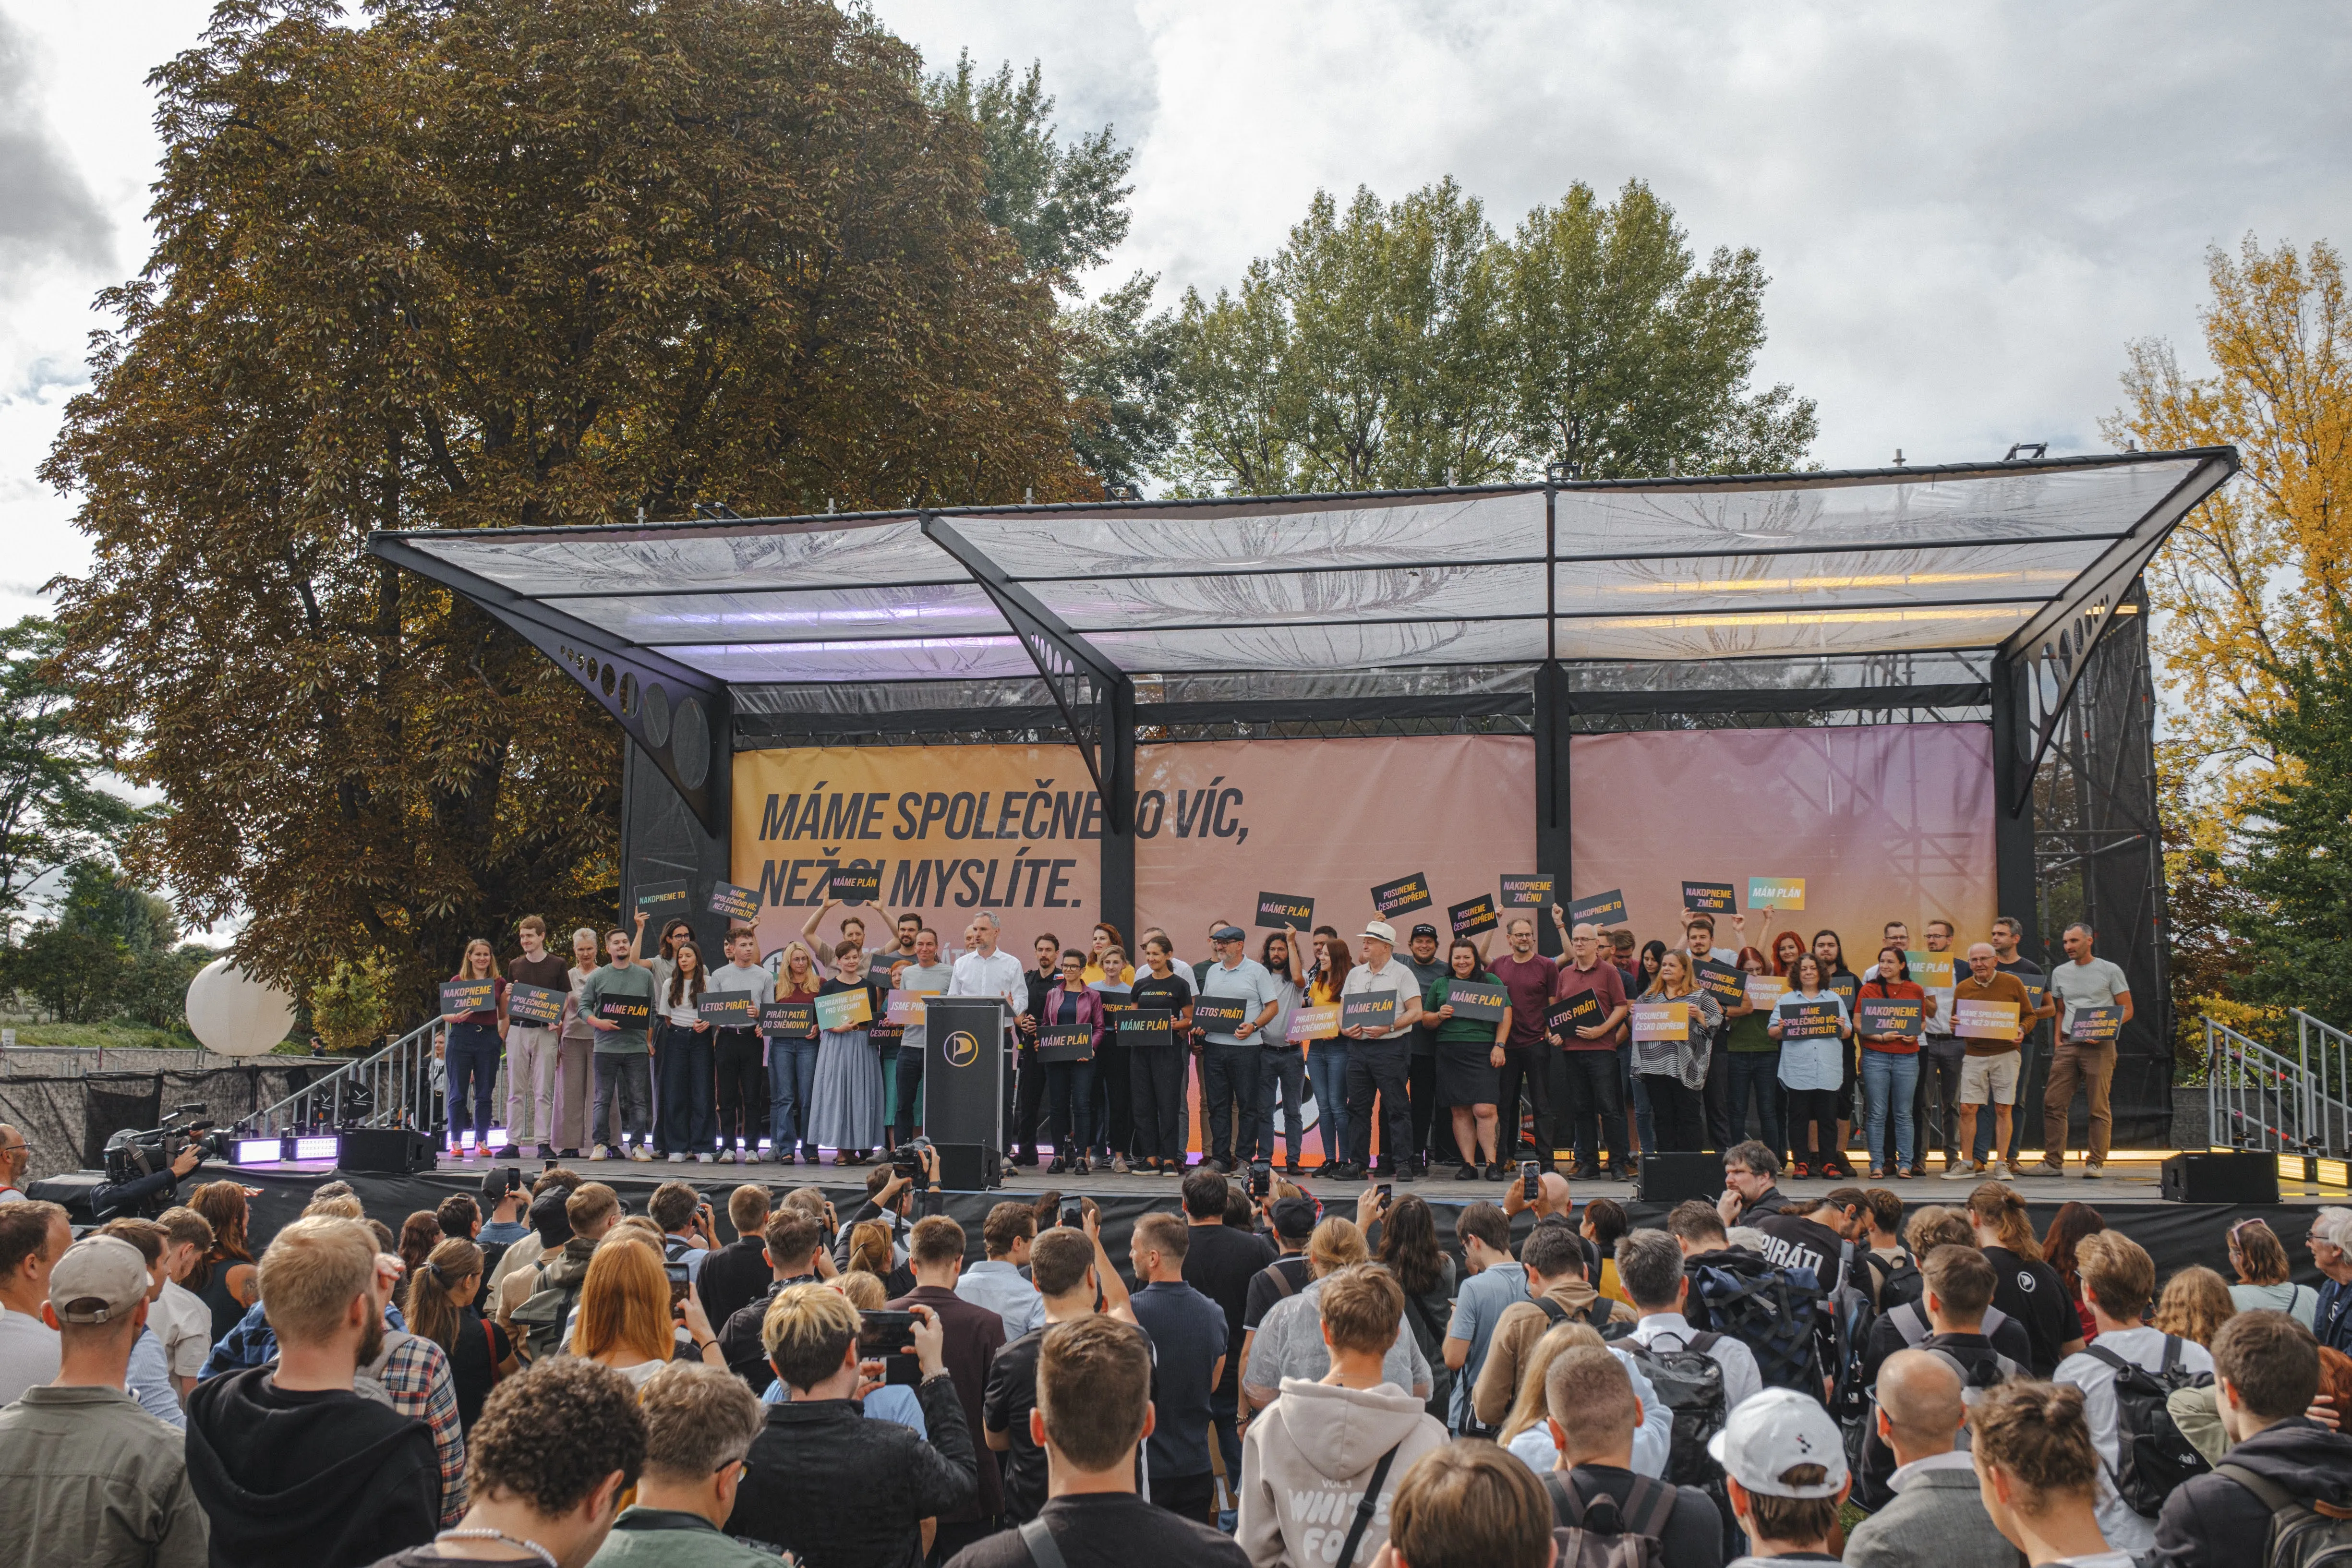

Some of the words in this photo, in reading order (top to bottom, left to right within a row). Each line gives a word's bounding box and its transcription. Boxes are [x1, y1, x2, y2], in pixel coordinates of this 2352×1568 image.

[759, 781, 891, 841] MÁME
[1176, 776, 1249, 844] VÍC,
[759, 847, 842, 907] NEŽ
[889, 846, 1082, 908] MYSLÍTE.
[832, 876, 856, 886] MÁME
[856, 876, 878, 887] PLÁN
[1383, 882, 1416, 900] POSUNEME
[1503, 881, 1552, 891] NAKOPNEME
[1752, 886, 1776, 897] MÁM
[1777, 887, 1801, 898] PLÁN
[639, 893, 676, 905] NAKOPNEME
[730, 889, 748, 899] MÁME
[1514, 891, 1542, 902] ZMĚNU
[1686, 888, 1732, 898] NAKOPNEME
[713, 894, 748, 907] SPOLEČNÉHO
[1378, 899, 1398, 911] ČESKO
[1399, 889, 1427, 905] DOPŘEDU
[1697, 898, 1724, 908] ZMĚNU
[713, 902, 726, 911] NEŽ
[1261, 902, 1287, 915] MÁME
[1287, 905, 1310, 917] PLÁN
[1458, 904, 1486, 920] POSUNEME
[1574, 903, 1612, 920] NAKOPNEME
[1613, 901, 1621, 909] TO
[1454, 919, 1470, 931] ČESKO
[1471, 911, 1495, 926] DOPŘEDU
[1907, 960, 1926, 972] ÁME
[1926, 961, 1950, 973] PLÁN
[1700, 969, 1737, 985] POSUNEME
[443, 985, 492, 998] NAKOPNEME
[530, 990, 549, 1000] MÁME
[1711, 982, 1743, 997] DOPŘEDU
[454, 997, 482, 1008] ZMĚNU
[512, 995, 550, 1009] SPOLEČNÉHO
[550, 1002, 561, 1012] VÍC,
[818, 995, 849, 1008] OCHRÁNÍME
[1450, 990, 1479, 1004] MÁME
[1478, 994, 1503, 1007] PLÁN
[603, 1002, 627, 1014] MÁME
[627, 1004, 648, 1016] PLÁN
[700, 1002, 724, 1012] LETOS
[725, 999, 749, 1010] PIRÁTI
[826, 1006, 836, 1014] PRO
[837, 1002, 861, 1012] VŠECHNY
[890, 1002, 909, 1011] JSME
[1346, 1001, 1371, 1014] MÁME
[1371, 999, 1393, 1012] PLÁN
[1800, 1006, 1821, 1015] MÁME
[1865, 1006, 1919, 1017] NAKOPNEME
[512, 1004, 525, 1013] NEŽ
[531, 1008, 557, 1020] MYSLÍTE
[766, 1009, 787, 1018] PIRÁTI
[788, 1010, 808, 1019] PATŘÍ
[1195, 1007, 1219, 1017] LETOS
[1219, 1008, 1244, 1019] PIRÁTI
[1295, 1013, 1316, 1024] PIRÁTI
[1316, 1011, 1335, 1021] PATŘÍ
[1549, 1010, 1572, 1027] LETOS
[1572, 1000, 1596, 1017] PIRÁTI
[1635, 1011, 1670, 1020] POSUNEME
[773, 1019, 810, 1029] SNĚMOVNY
[1120, 1019, 1146, 1031] MÁME
[1146, 1018, 1169, 1030] PLÁN
[1301, 1021, 1337, 1032] SNĚMOVNY
[1635, 1021, 1656, 1031] ČESKO
[1784, 1015, 1825, 1026] SPOLEČNÉHO
[1875, 1017, 1907, 1029] ZMĚNU
[870, 1028, 890, 1037] ČESKO
[1787, 1027, 1801, 1036] NEŽ
[1809, 1024, 1836, 1035] MYSLÍTE
[1040, 1035, 1065, 1047] MÁME
[1067, 1033, 1089, 1045] PLÁN
